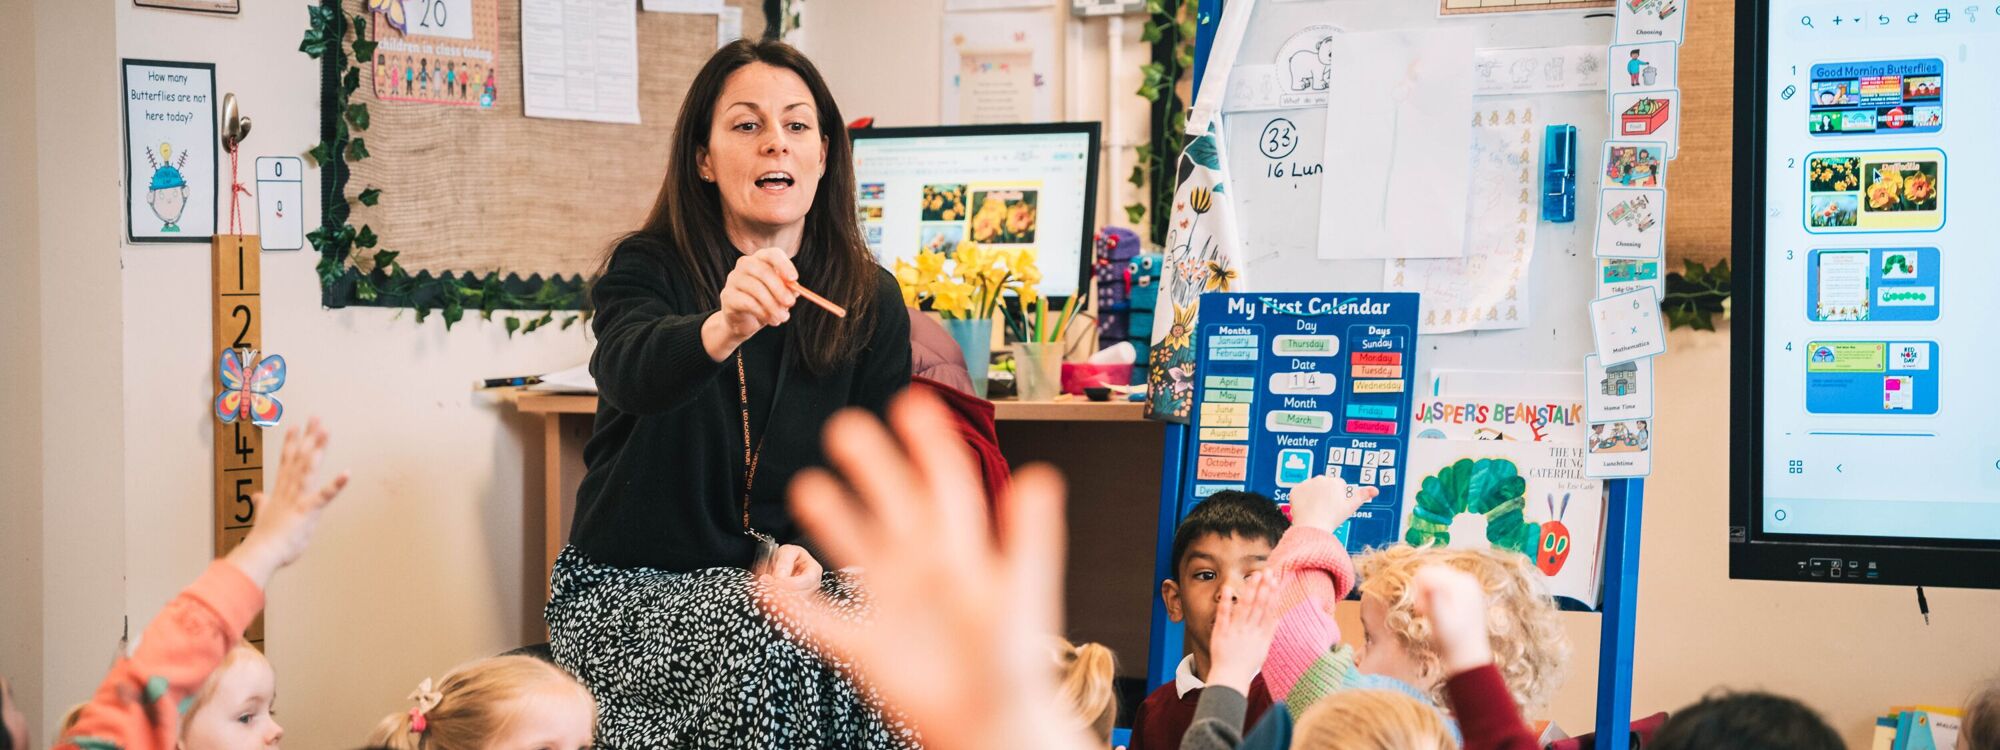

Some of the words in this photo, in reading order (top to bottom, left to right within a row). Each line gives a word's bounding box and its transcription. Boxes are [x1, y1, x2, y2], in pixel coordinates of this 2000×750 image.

[420, 0, 447, 28] 20
[1791, 66, 1797, 75] 1
[1816, 66, 1843, 78] Good
[1844, 65, 1885, 77] Morning
[1887, 63, 1937, 75] Butterflies
[148, 71, 165, 82] How
[167, 73, 188, 85] many
[131, 89, 176, 102] Butterflies
[177, 94, 191, 103] are
[193, 94, 206, 103] not
[145, 110, 164, 121] here
[166, 111, 193, 123] today?
[1269, 127, 1290, 152] 33
[275, 161, 282, 177] 0
[1788, 159, 1795, 169] 2
[1267, 162, 1284, 178] 16
[1291, 162, 1323, 177] Lun
[1787, 250, 1794, 260] 3
[1228, 297, 1255, 320] My
[1262, 297, 1303, 315] First
[1308, 297, 1391, 315] Calendar
[232, 304, 252, 349] 2
[1219, 326, 1252, 335] Months
[1297, 319, 1317, 334] Day
[1368, 326, 1391, 338] Days
[1218, 336, 1249, 347] January
[1288, 339, 1324, 351] Thursday
[1362, 339, 1393, 350] Sunday
[1785, 342, 1792, 352] 4
[1216, 348, 1251, 359] February
[1360, 353, 1393, 364] Monday
[1292, 358, 1316, 370] Date
[1361, 366, 1393, 377] Tuesday
[1219, 377, 1239, 388] April
[1355, 381, 1401, 392] Wednesday
[1220, 391, 1237, 402] May
[1284, 396, 1317, 409] Month
[1622, 403, 1636, 411] Time
[1215, 404, 1234, 414] June
[1358, 406, 1383, 417] Friday
[1416, 401, 1489, 424] JASPER'S
[1493, 401, 1583, 426] BEANSTALK
[1216, 415, 1232, 426] July
[1286, 414, 1312, 425] March
[1353, 421, 1390, 433] Saturday
[1210, 429, 1238, 439] August
[234, 422, 254, 464] 4
[1277, 435, 1319, 447] Weather
[1352, 439, 1377, 449] Dates
[1202, 444, 1245, 455] September
[1549, 447, 1570, 457] THE
[1206, 457, 1237, 467] October
[1332, 449, 1341, 461] 0
[1367, 453, 1375, 466] 2
[1382, 451, 1390, 464] 2
[1201, 469, 1241, 479] November
[1364, 469, 1372, 482] 5
[1382, 471, 1391, 484] 6
[234, 479, 253, 523] 5
